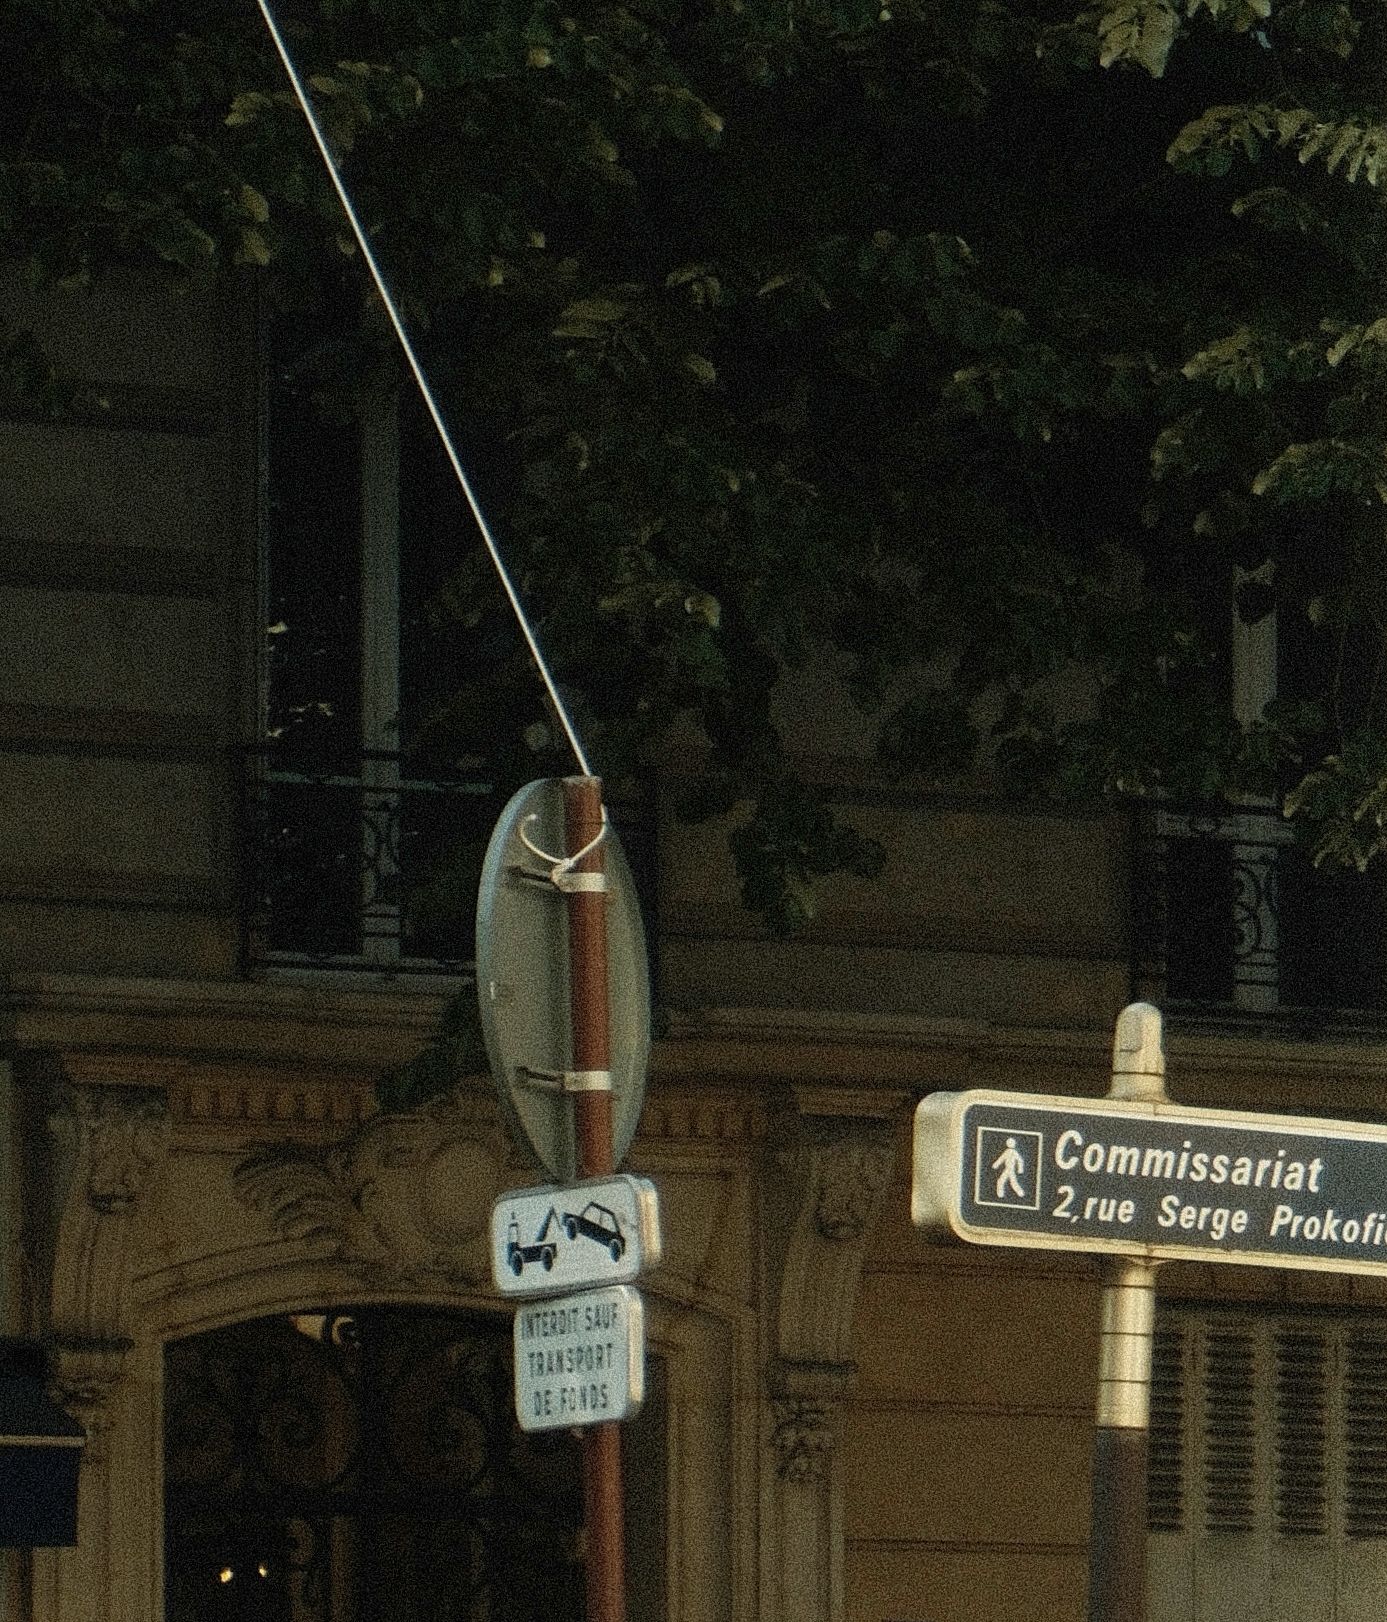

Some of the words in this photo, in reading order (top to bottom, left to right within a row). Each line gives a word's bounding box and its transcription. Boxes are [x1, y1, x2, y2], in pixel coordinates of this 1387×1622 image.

[1055, 1130, 1321, 1194] Commissariat
[1157, 1194, 1248, 1241] Serge
[521, 1306, 579, 1341] INTERDIT
[584, 1302, 618, 1333] SAUF
[528, 1342, 613, 1378] TRANSPORT
[533, 1389, 552, 1416] DE
[560, 1383, 608, 1415] FONDS
